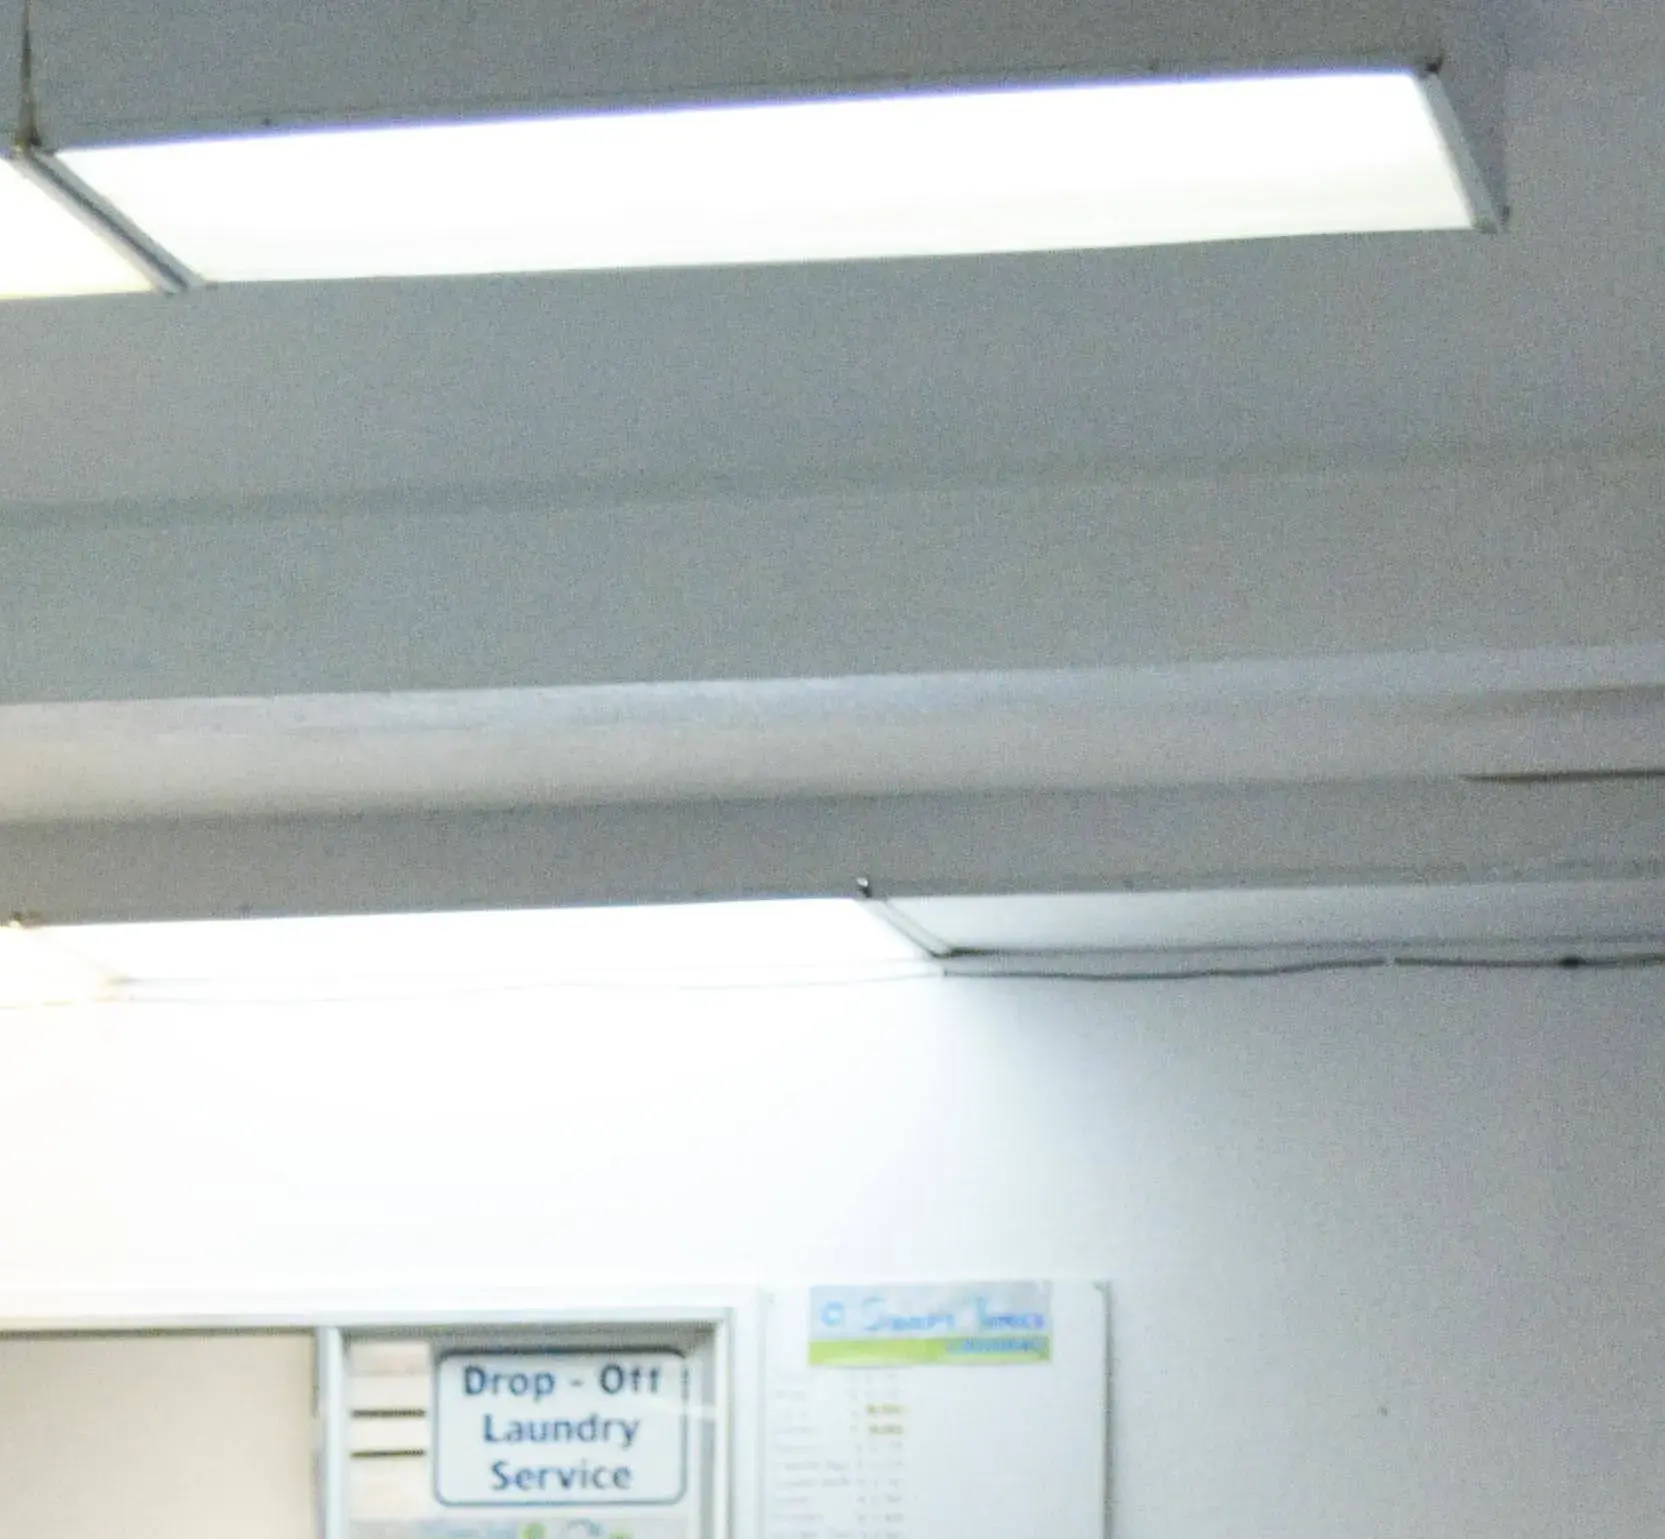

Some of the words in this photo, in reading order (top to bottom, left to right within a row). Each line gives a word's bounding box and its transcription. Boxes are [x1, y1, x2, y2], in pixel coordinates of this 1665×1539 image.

[464, 1365, 555, 1402] Drop
[600, 1363, 660, 1394] Off
[483, 1413, 639, 1449] Laundry
[491, 1459, 631, 1490] Service
